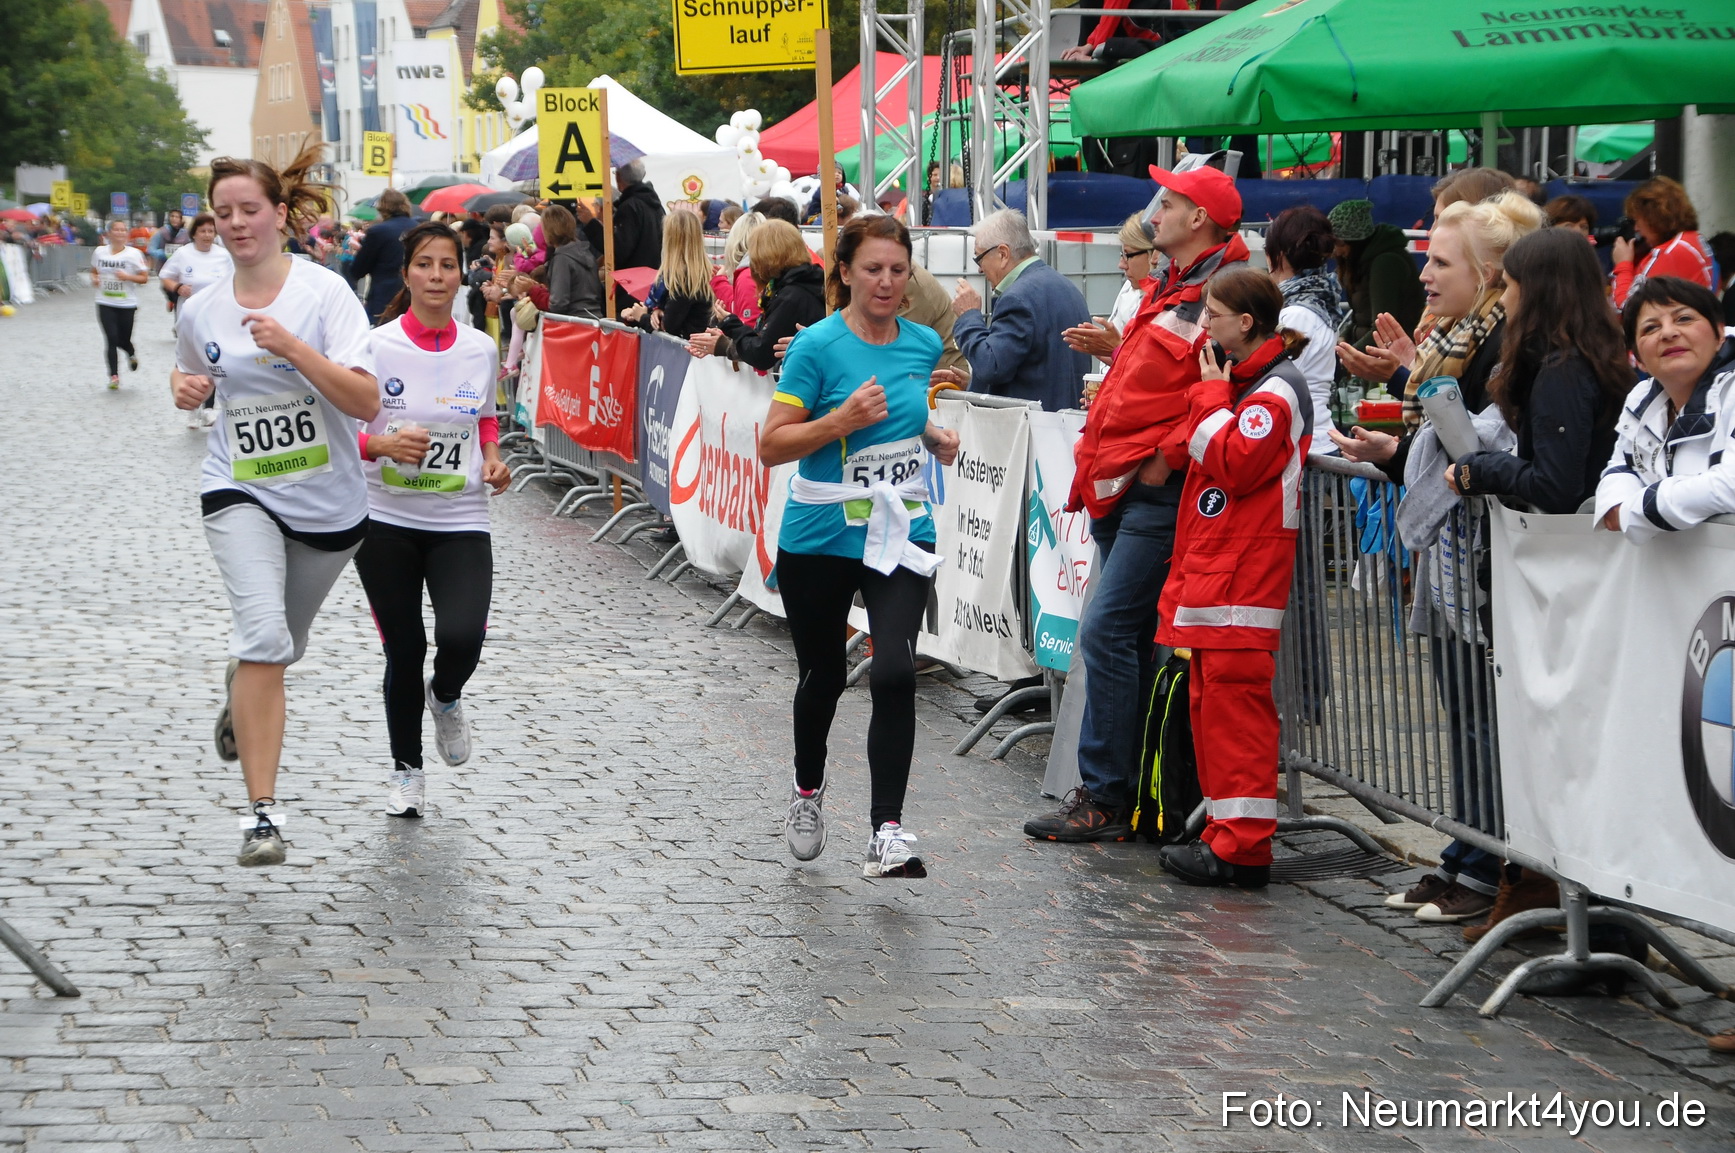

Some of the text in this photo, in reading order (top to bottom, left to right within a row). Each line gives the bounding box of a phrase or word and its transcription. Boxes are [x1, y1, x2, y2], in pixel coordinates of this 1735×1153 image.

[684, 0, 814, 18] Schnupper-
[1480, 5, 1687, 25] Neumarkter
[730, 23, 771, 44] lauf
[1450, 21, 1735, 48] Lammsbräu
[544, 92, 600, 112] Block
[367, 133, 391, 142] Block
[371, 145, 386, 167] B
[554, 122, 595, 174] A
[54, 188, 64, 201] C
[73, 199, 82, 210] D
[226, 400, 301, 418] PARTL Neumarkt
[235, 410, 316, 454] 5036
[427, 431, 458, 439] umarkt
[255, 456, 308, 476] Johanna
